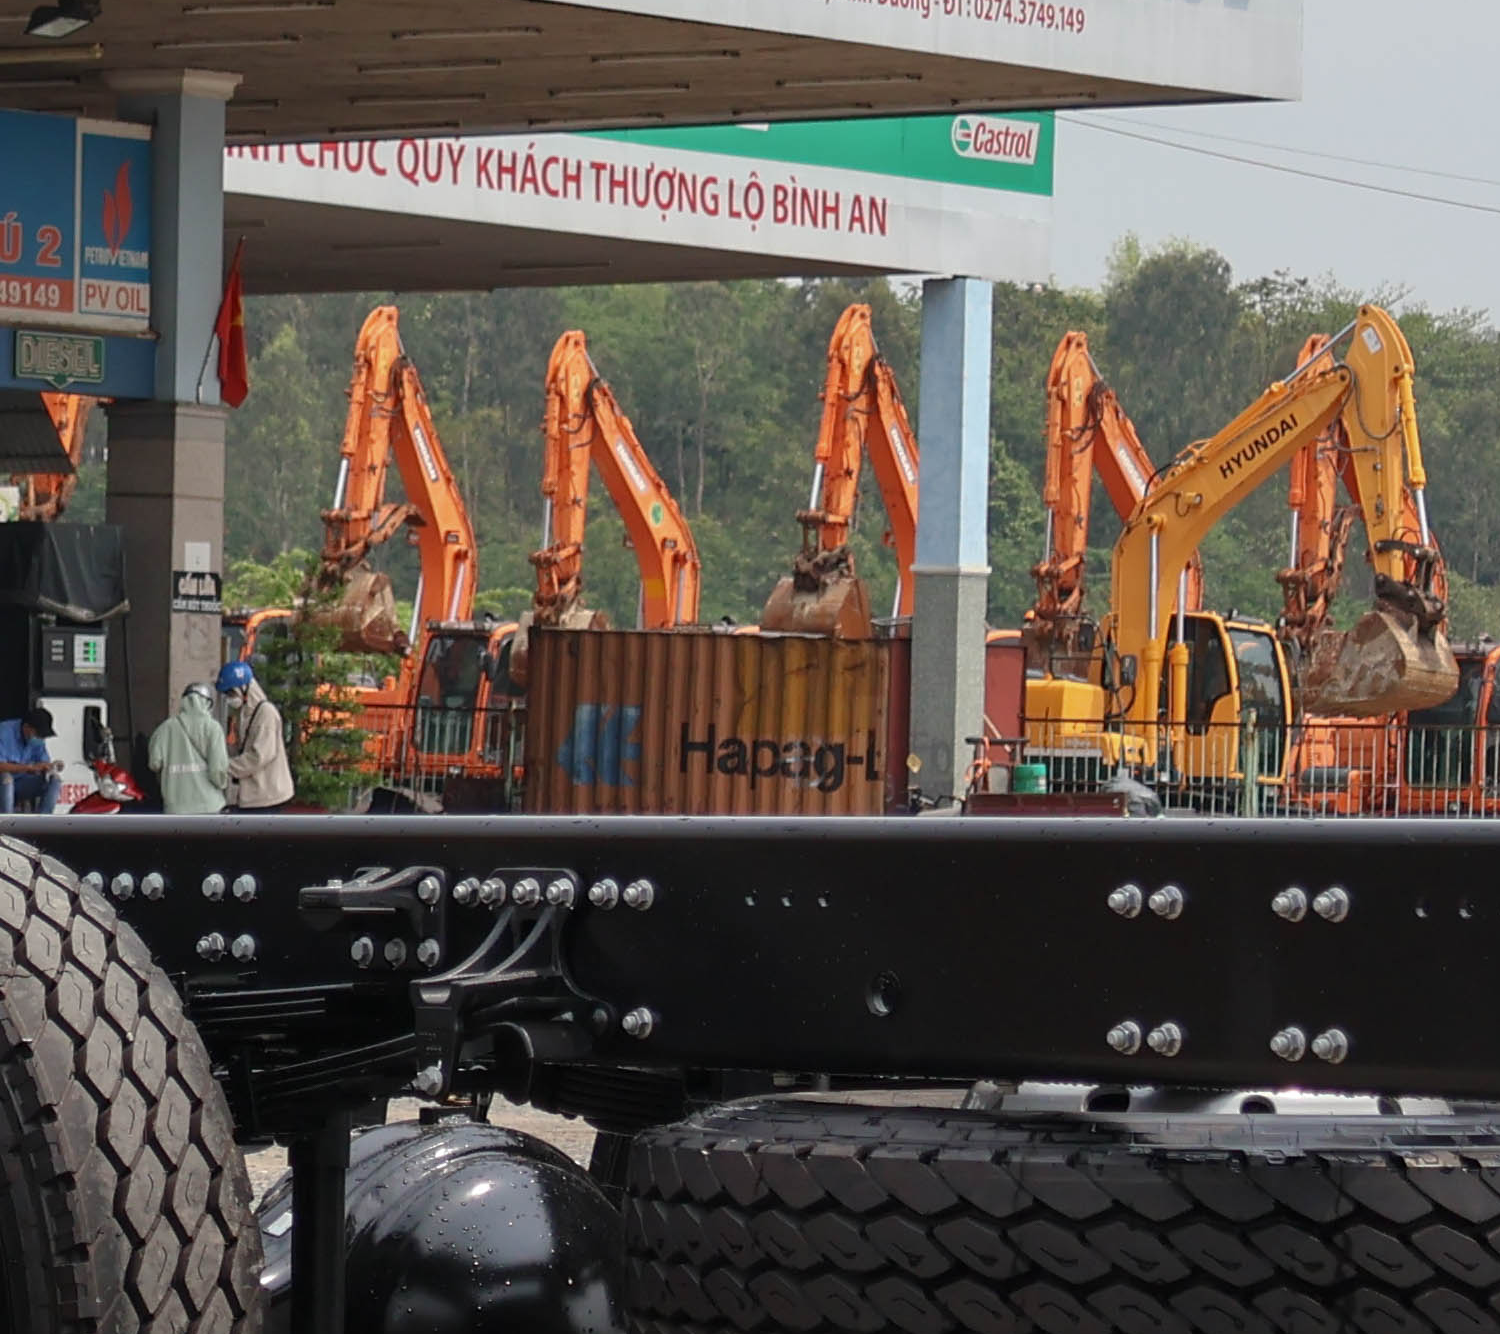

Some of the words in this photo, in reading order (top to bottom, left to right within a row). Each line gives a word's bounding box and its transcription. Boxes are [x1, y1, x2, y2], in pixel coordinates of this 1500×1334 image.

[972, 121, 1036, 159] Castrol
[476, 142, 582, 201] KHÁCH
[590, 160, 719, 222] THƯỢNG
[728, 170, 763, 231] LỘ
[773, 175, 841, 231] BÌNH
[847, 193, 888, 237] AN
[35, 225, 63, 268] 2
[85, 285, 111, 310] PV
[115, 287, 147, 313] OIL
[22, 337, 99, 374] DIESEL
[1218, 413, 1299, 480] HYUNDAI
